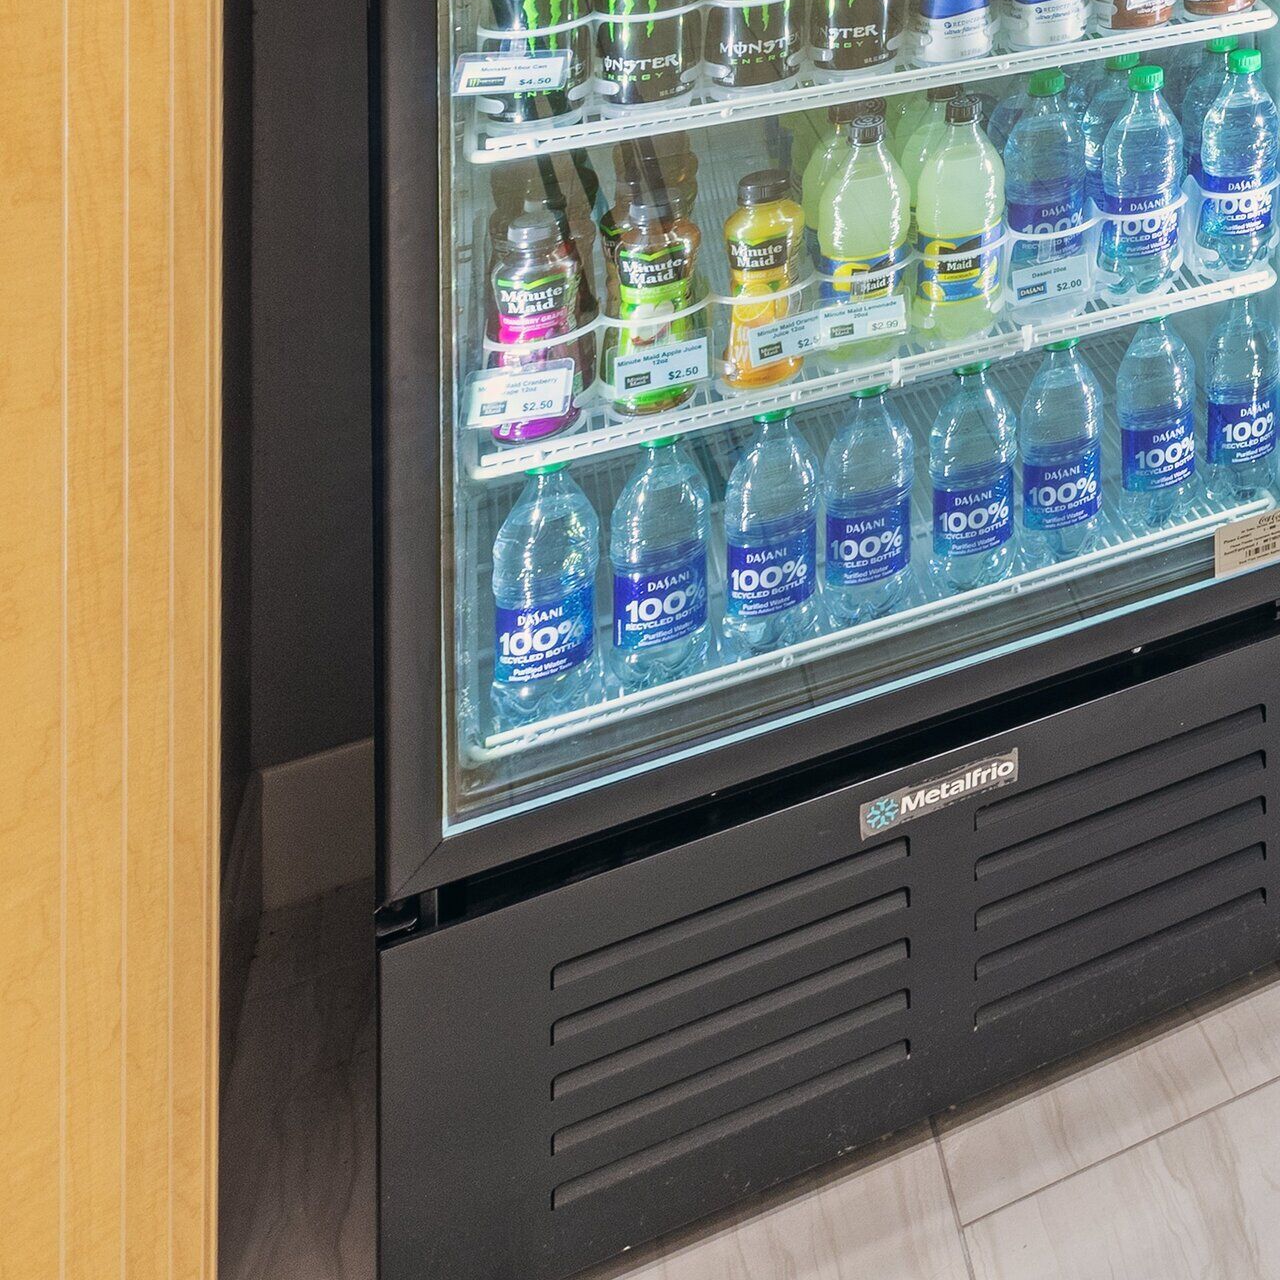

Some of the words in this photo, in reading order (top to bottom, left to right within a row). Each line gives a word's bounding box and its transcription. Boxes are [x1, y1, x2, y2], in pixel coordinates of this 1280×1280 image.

[519, 76, 552, 86] $4.50
[730, 243, 783, 258] Minute
[622, 258, 683, 274] Minute
[736, 255, 775, 268] Maid
[946, 259, 972, 271] Maid
[628, 270, 674, 285] Maid
[501, 286, 564, 303] Minute
[1019, 285, 1045, 297] DASANI
[1057, 278, 1082, 291] $2.00
[507, 299, 554, 315] Maid
[824, 310, 845, 319] Minute
[847, 306, 862, 314] Maid
[863, 300, 897, 311] Lemonade
[757, 327, 777, 338] Minute
[779, 323, 796, 333] Maid
[871, 320, 898, 330] $2.99
[617, 357, 642, 368] Minute
[644, 354, 660, 362] Maid
[662, 349, 680, 359] Apple
[682, 344, 702, 354] Juice
[668, 366, 699, 380] $2.50
[522, 399, 553, 412] $2.50
[1152, 426, 1186, 445] DASANI
[1135, 431, 1195, 468] 100%
[1044, 464, 1081, 481] DASANI
[955, 490, 993, 506] DASANI
[1029, 472, 1097, 507] 100%
[939, 497, 1009, 533] 100%
[846, 517, 885, 534] DASANI
[830, 525, 902, 560] 100%
[746, 547, 788, 564] DASANI
[647, 570, 691, 592] DASANI
[731, 554, 808, 592] 100%
[730, 587, 773, 600] RECYCLED
[774, 576, 807, 591] BOTTLE
[625, 582, 707, 624] 100%
[770, 595, 792, 605] Water
[516, 606, 563, 627] DASANI
[499, 620, 585, 656] 100%
[901, 761, 1014, 814] Metalfrio
